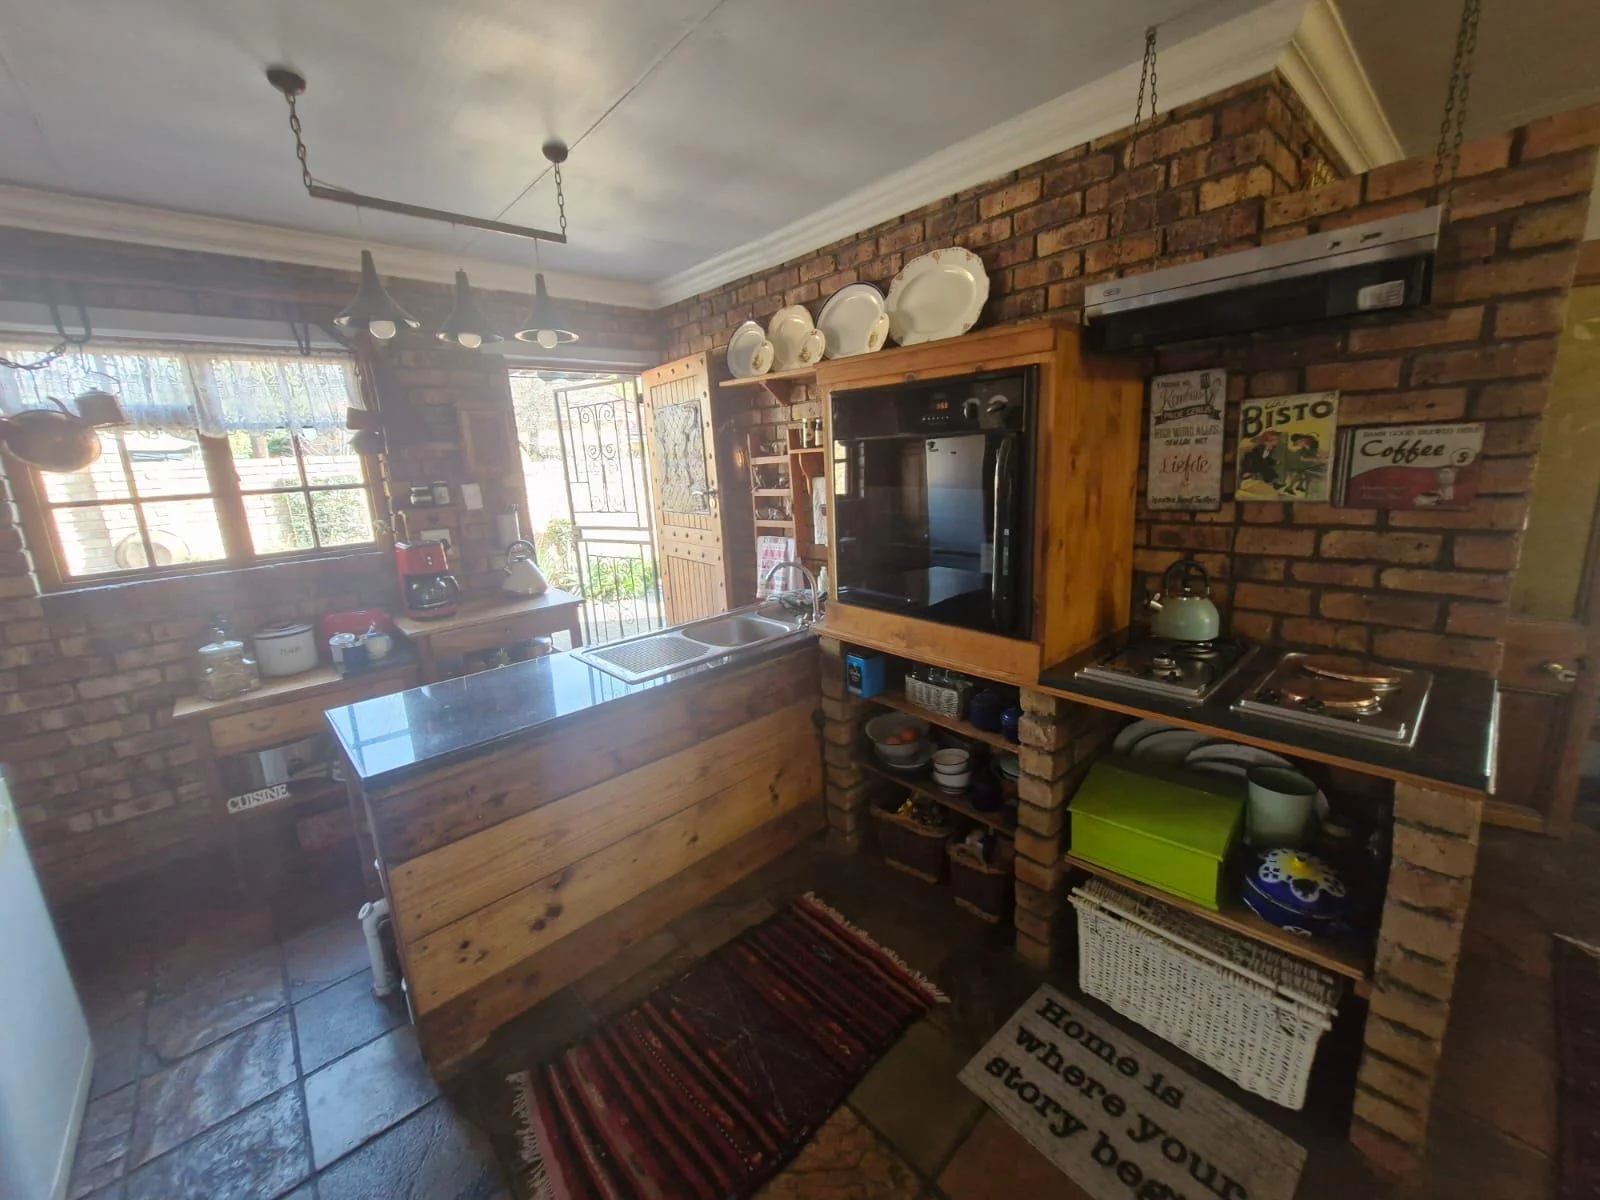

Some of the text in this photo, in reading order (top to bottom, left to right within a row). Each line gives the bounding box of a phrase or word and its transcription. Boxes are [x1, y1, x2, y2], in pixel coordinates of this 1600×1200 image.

[1242, 400, 1334, 437] BISTO
[1159, 453, 1211, 482] Liefde
[1360, 439, 1446, 464] Coffee
[227, 784, 291, 814] CUISINE
[1035, 997, 1185, 1110] Home is
[985, 1055, 1088, 1138] story
[1015, 1025, 1249, 1200] where your
